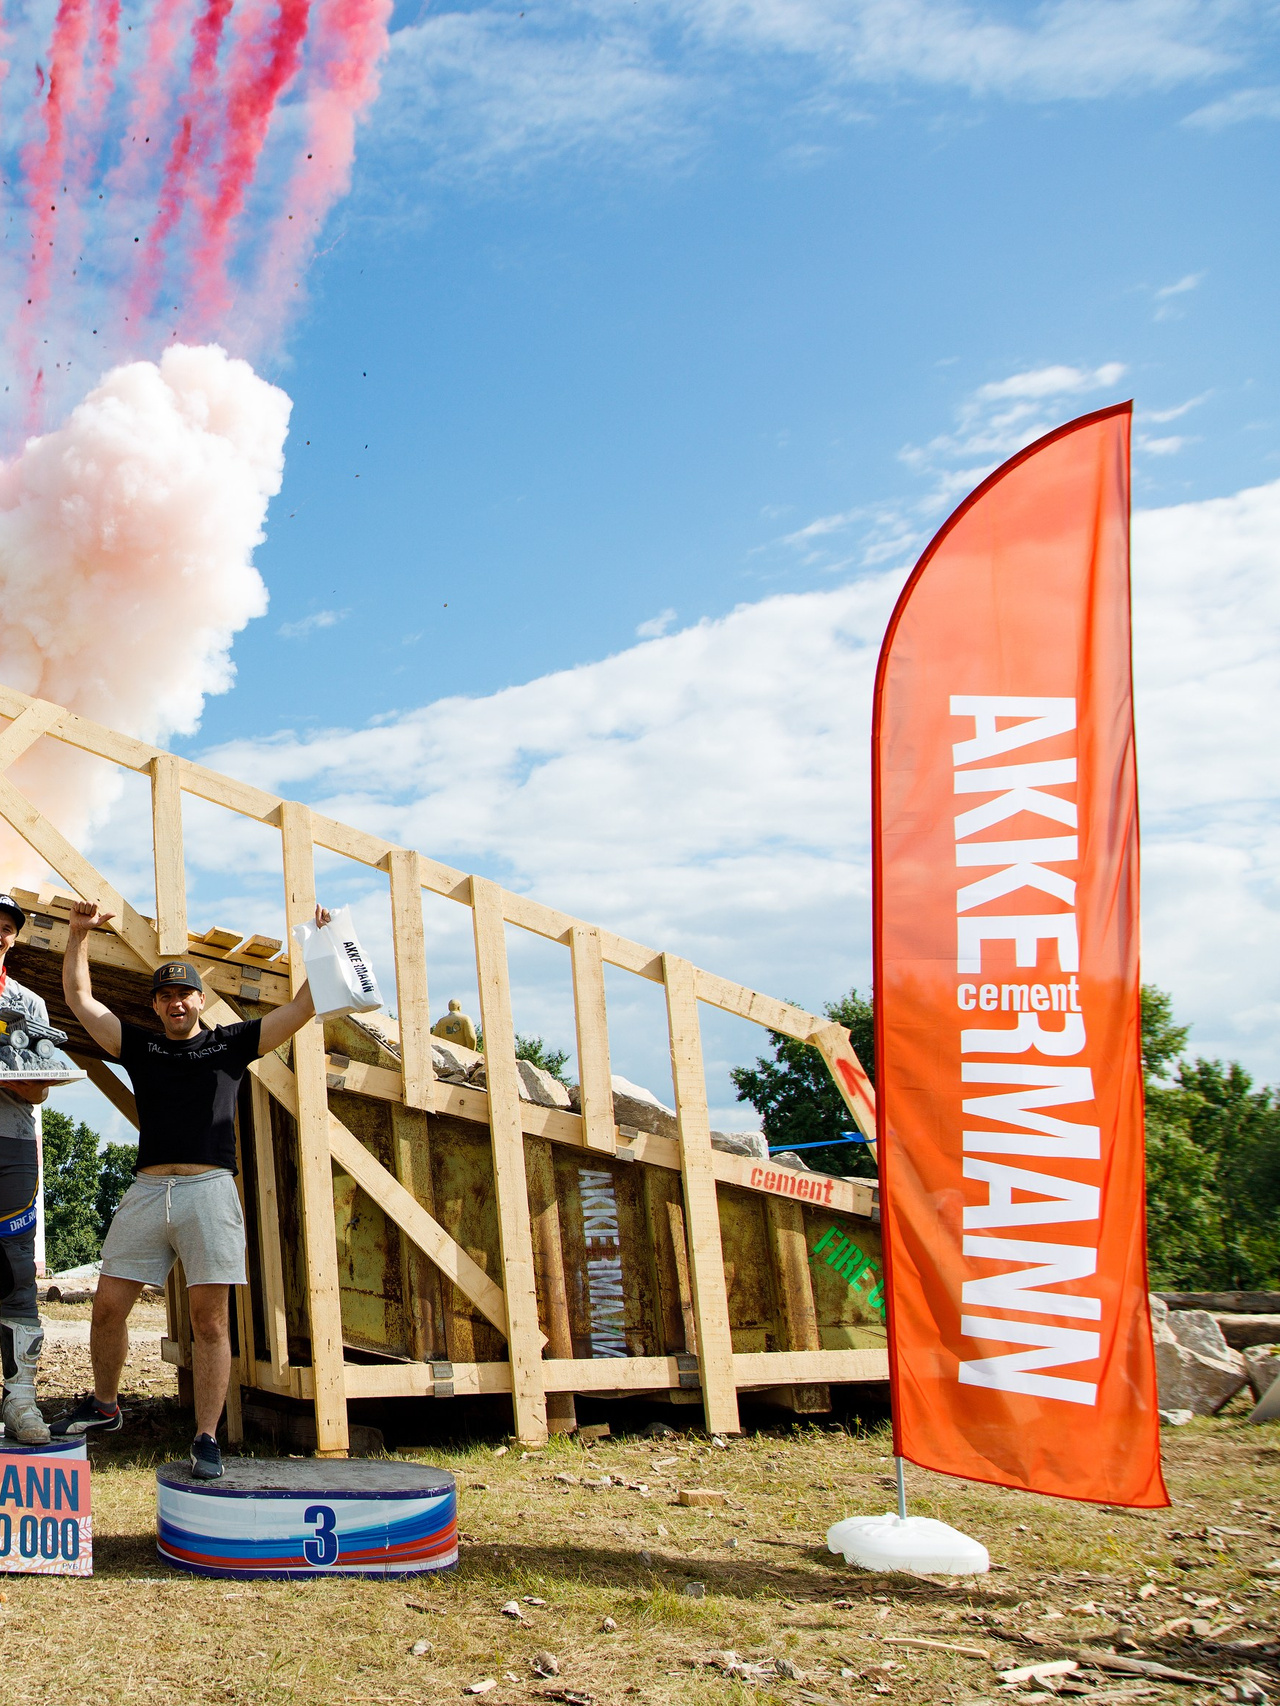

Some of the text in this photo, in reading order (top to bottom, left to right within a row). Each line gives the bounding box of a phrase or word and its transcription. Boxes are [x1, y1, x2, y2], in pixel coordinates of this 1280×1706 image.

[957, 975, 1081, 1012] cement
[750, 1167, 834, 1204] cement
[812, 1225, 878, 1292] FIRE
[19, 1515, 79, 1561] 000
[303, 1505, 339, 1567] 3
